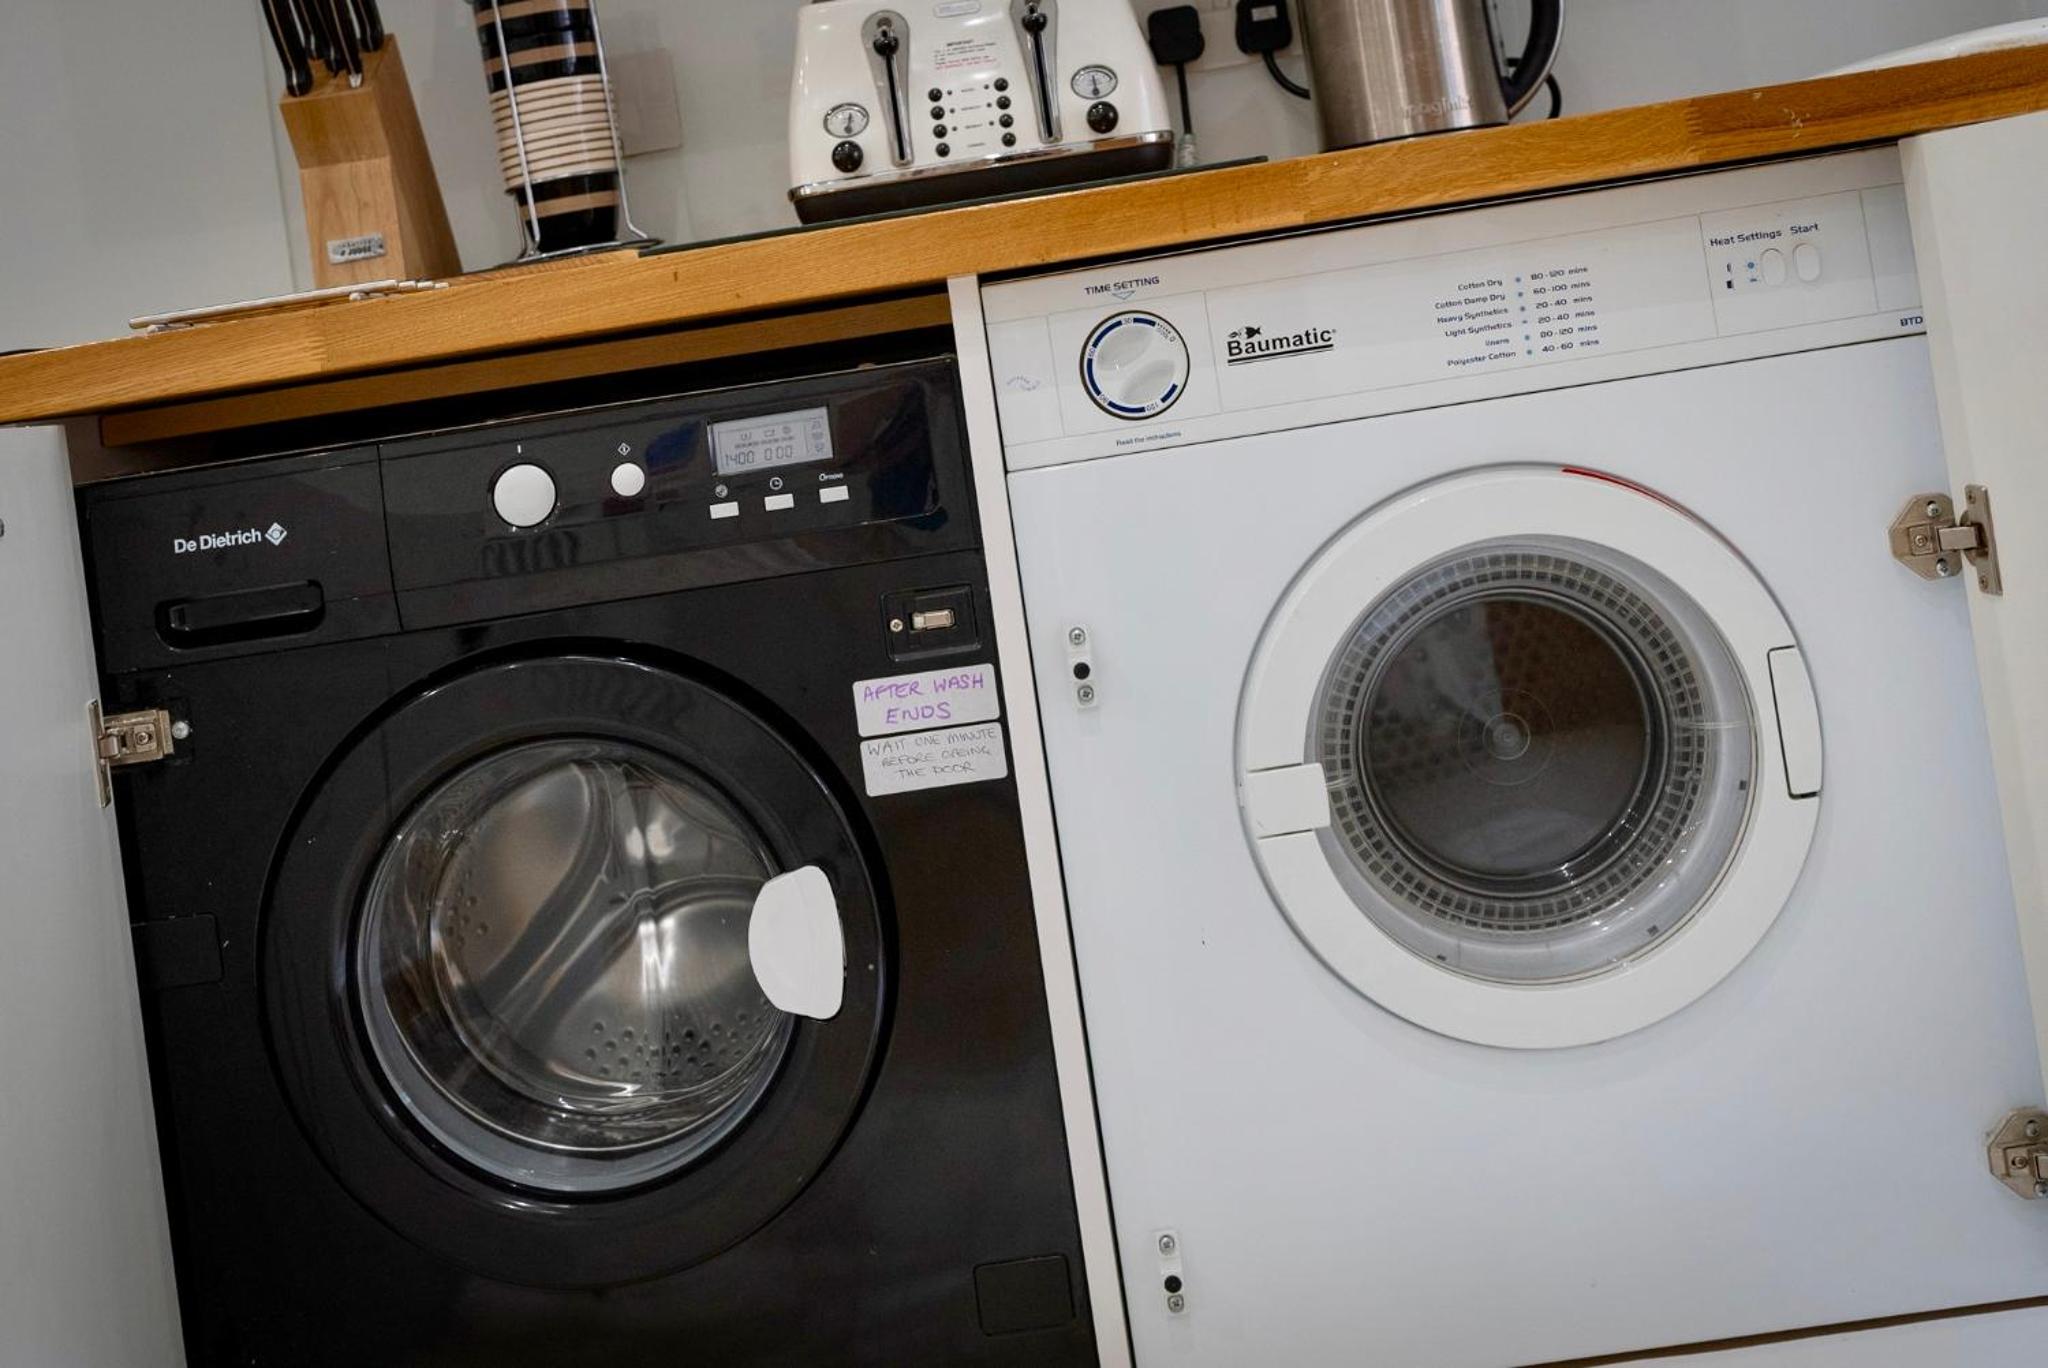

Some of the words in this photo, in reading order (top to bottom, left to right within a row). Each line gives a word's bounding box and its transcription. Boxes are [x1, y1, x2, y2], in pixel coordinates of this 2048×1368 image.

[1710, 235, 1735, 247] Heat
[1737, 229, 1782, 243] Settings
[1790, 222, 1819, 236] Start
[1084, 284, 1111, 295] TIME
[1113, 276, 1160, 289] SETTING
[1457, 281, 1486, 291] Cotton
[1486, 279, 1503, 287] Dry
[1568, 267, 1588, 275] mins
[1434, 300, 1463, 310] Cotton
[1464, 296, 1488, 305] Damp
[1489, 294, 1506, 302] Dry
[1571, 281, 1591, 289] mins
[1437, 314, 1463, 323] Heavy
[1464, 308, 1509, 319] Synthetics
[1573, 296, 1593, 304] mins
[1445, 328, 1466, 337] Light
[1467, 322, 1513, 334] Synthetics
[1575, 310, 1595, 318] mins
[1227, 328, 1333, 357] Baumatic
[1447, 356, 1487, 366] Polyester
[1488, 351, 1517, 360] Cotton
[174, 538, 198, 554] De
[199, 528, 262, 550] Dietrich
[863, 680, 924, 702] AFTER
[934, 672, 985, 694] WASH
[886, 701, 952, 724] ENDS
[868, 738, 906, 756] WAIT
[915, 734, 942, 746] ONE
[948, 727, 998, 745] MINUTE
[881, 752, 933, 768] BEFORE
[894, 768, 926, 779] THE
[931, 761, 976, 776] DOOR
